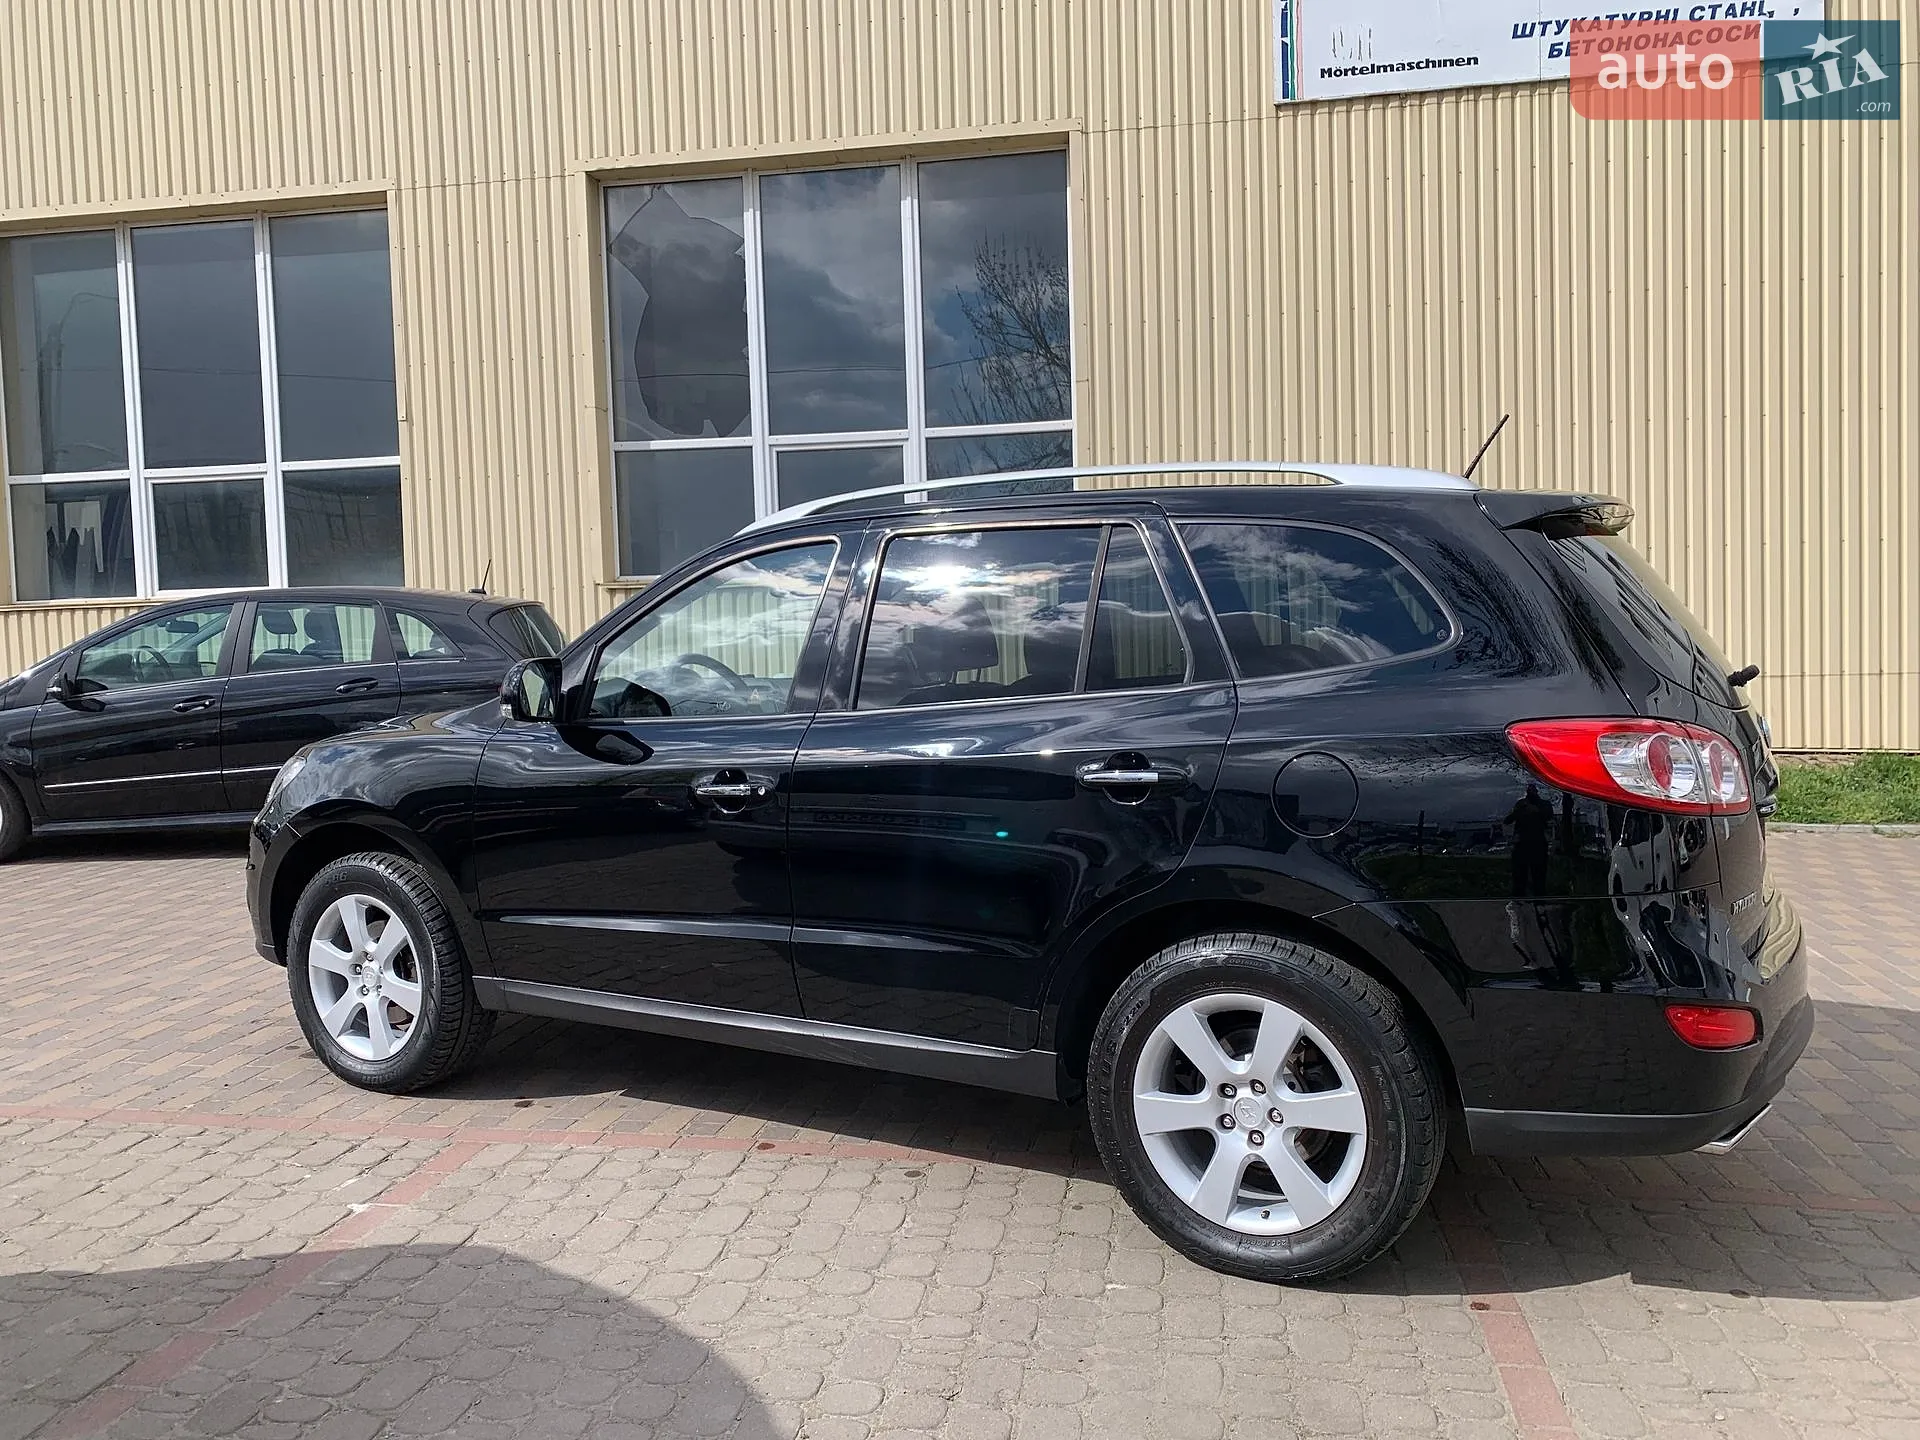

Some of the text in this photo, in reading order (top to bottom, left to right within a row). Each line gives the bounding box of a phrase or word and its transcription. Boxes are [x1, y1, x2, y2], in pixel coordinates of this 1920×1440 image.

[1511, 7, 1680, 40] ШТУКАТУРНІ
[1547, 23, 1761, 59] БЕТОНОНАСОСИ
[1320, 55, 1479, 79] Mörtelmaschinen
